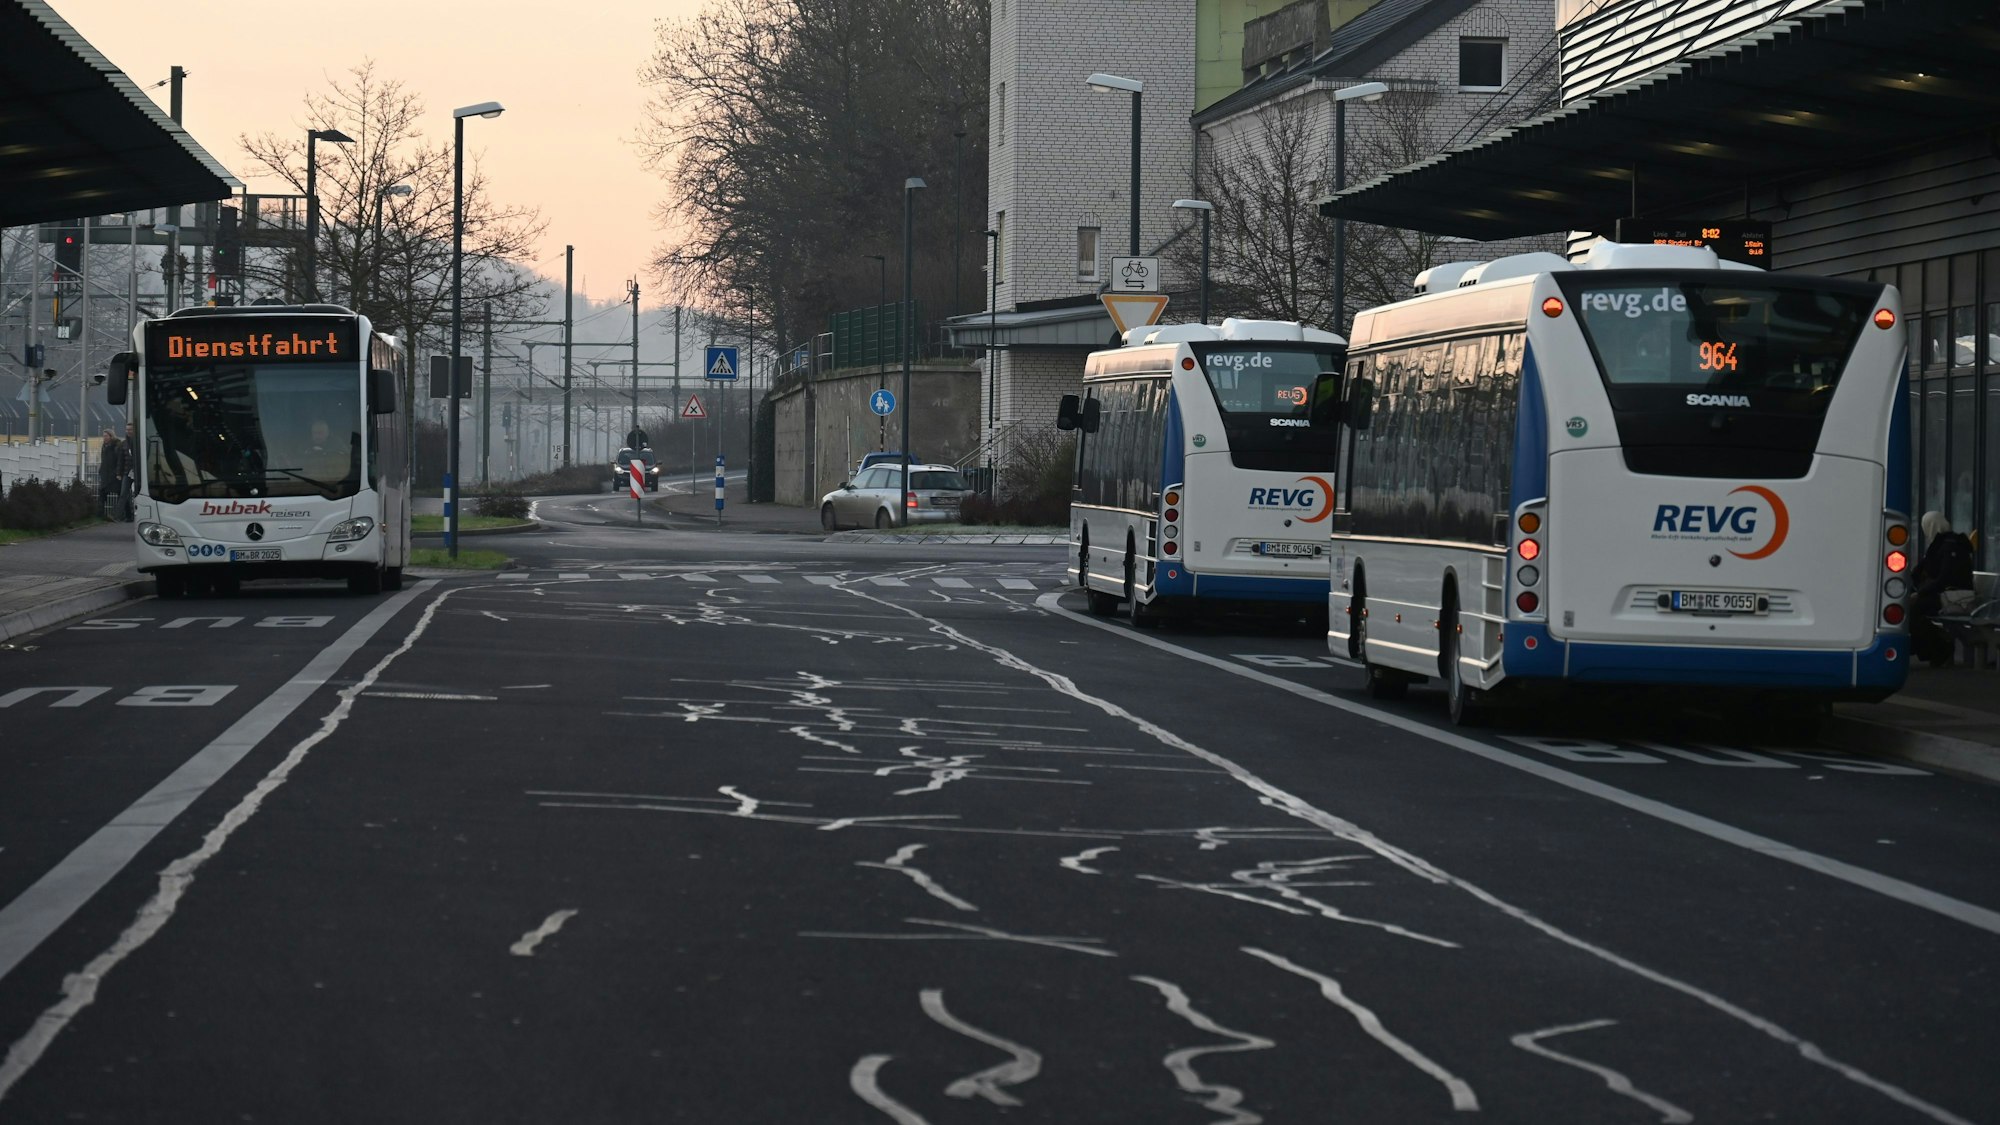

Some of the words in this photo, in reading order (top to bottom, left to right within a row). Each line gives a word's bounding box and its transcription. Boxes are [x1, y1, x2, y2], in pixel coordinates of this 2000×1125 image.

[1702, 228, 1720, 239] 8:02
[1581, 288, 1687, 318] revg.de
[168, 332, 338, 358] Dienstfahrt
[1205, 351, 1273, 371] revg.de
[1699, 341, 1738, 371] 964
[1277, 389, 1301, 399] REVG
[1686, 393, 1751, 407] SCANIA
[1269, 418, 1311, 428] SCANIA
[1565, 420, 1583, 428] VRS
[1248, 487, 1315, 507] REVG
[200, 500, 272, 515] bubak
[270, 508, 311, 518] reisen
[1653, 504, 1758, 534] REVG
[235, 551, 245, 560] BM
[250, 551, 260, 559] BR
[261, 550, 280, 559] 2025
[1266, 543, 1277, 552] BM
[1281, 544, 1291, 553] RE
[1292, 544, 1312, 554] 9045
[1681, 594, 1697, 607] BM
[1705, 595, 1720, 607] RE
[1723, 595, 1753, 608] 9055
[67, 616, 335, 630] BUS
